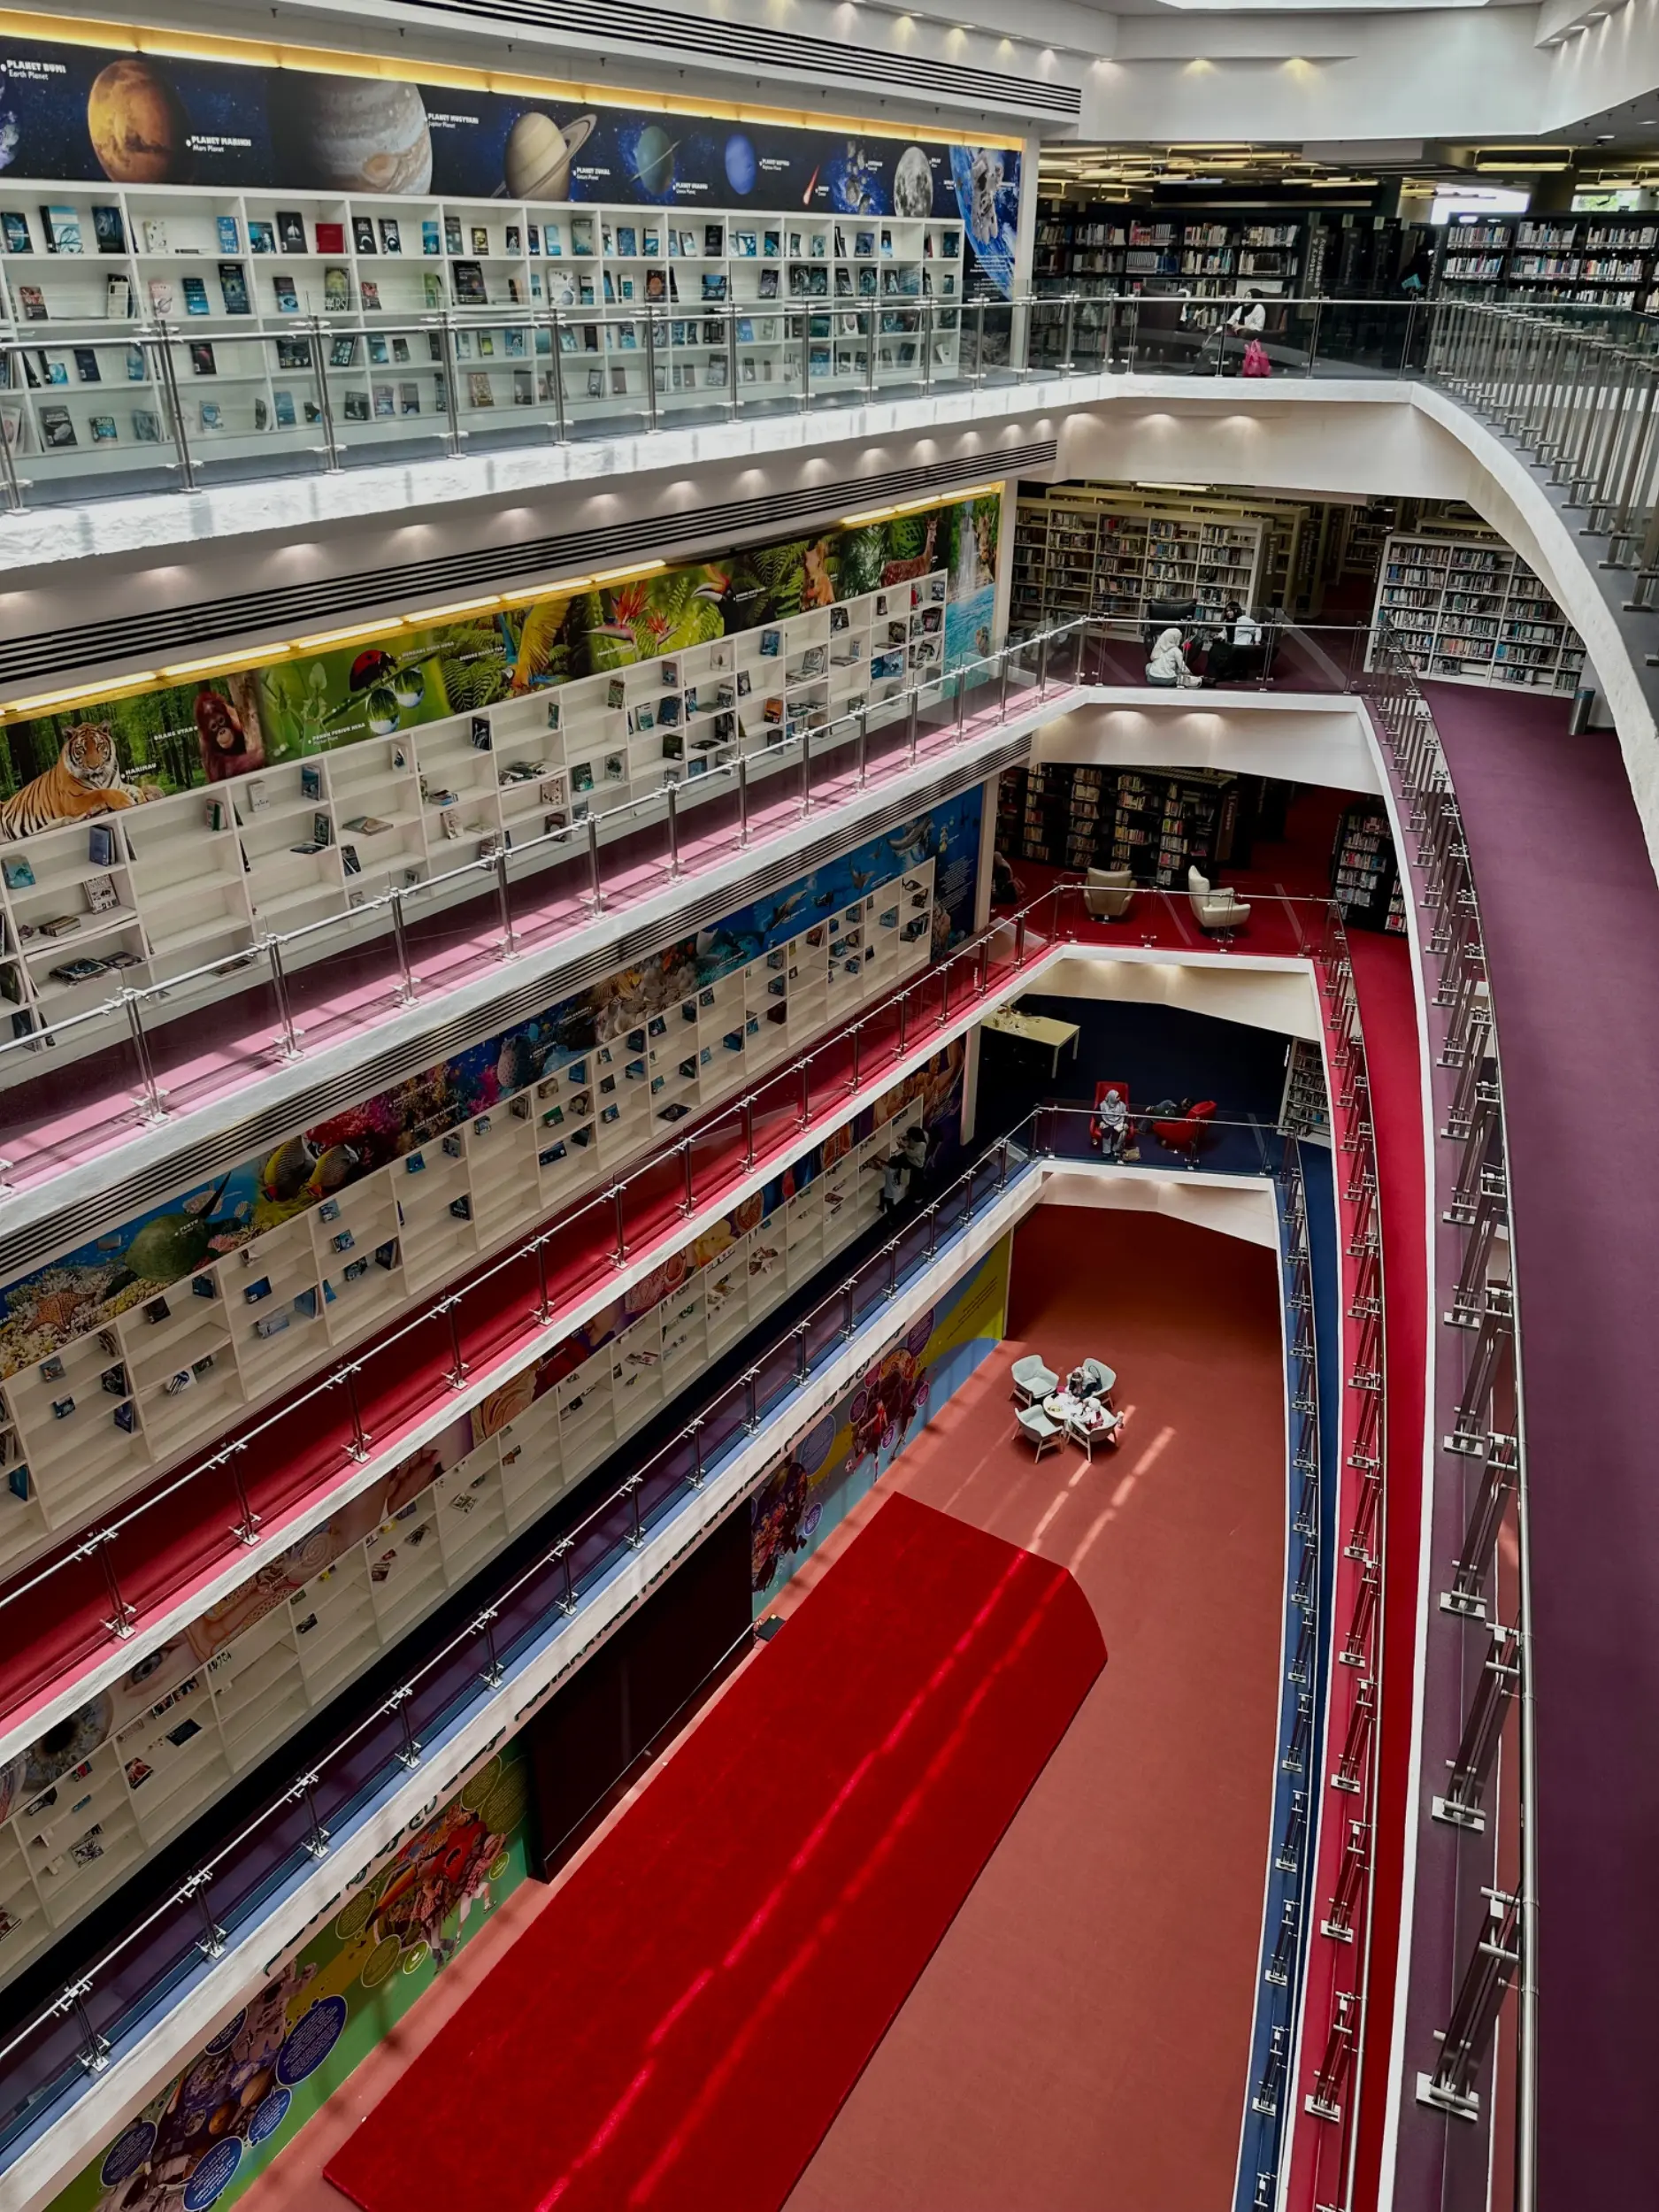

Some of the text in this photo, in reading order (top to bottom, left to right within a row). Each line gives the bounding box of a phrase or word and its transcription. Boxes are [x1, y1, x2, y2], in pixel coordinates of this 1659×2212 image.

[6, 59, 66, 73] PLANET BUMI
[191, 135, 219, 145] PLANET
[1307, 248, 1317, 282] history
[154, 732, 176, 741] ORANG
[125, 763, 157, 775] HARIMAU
